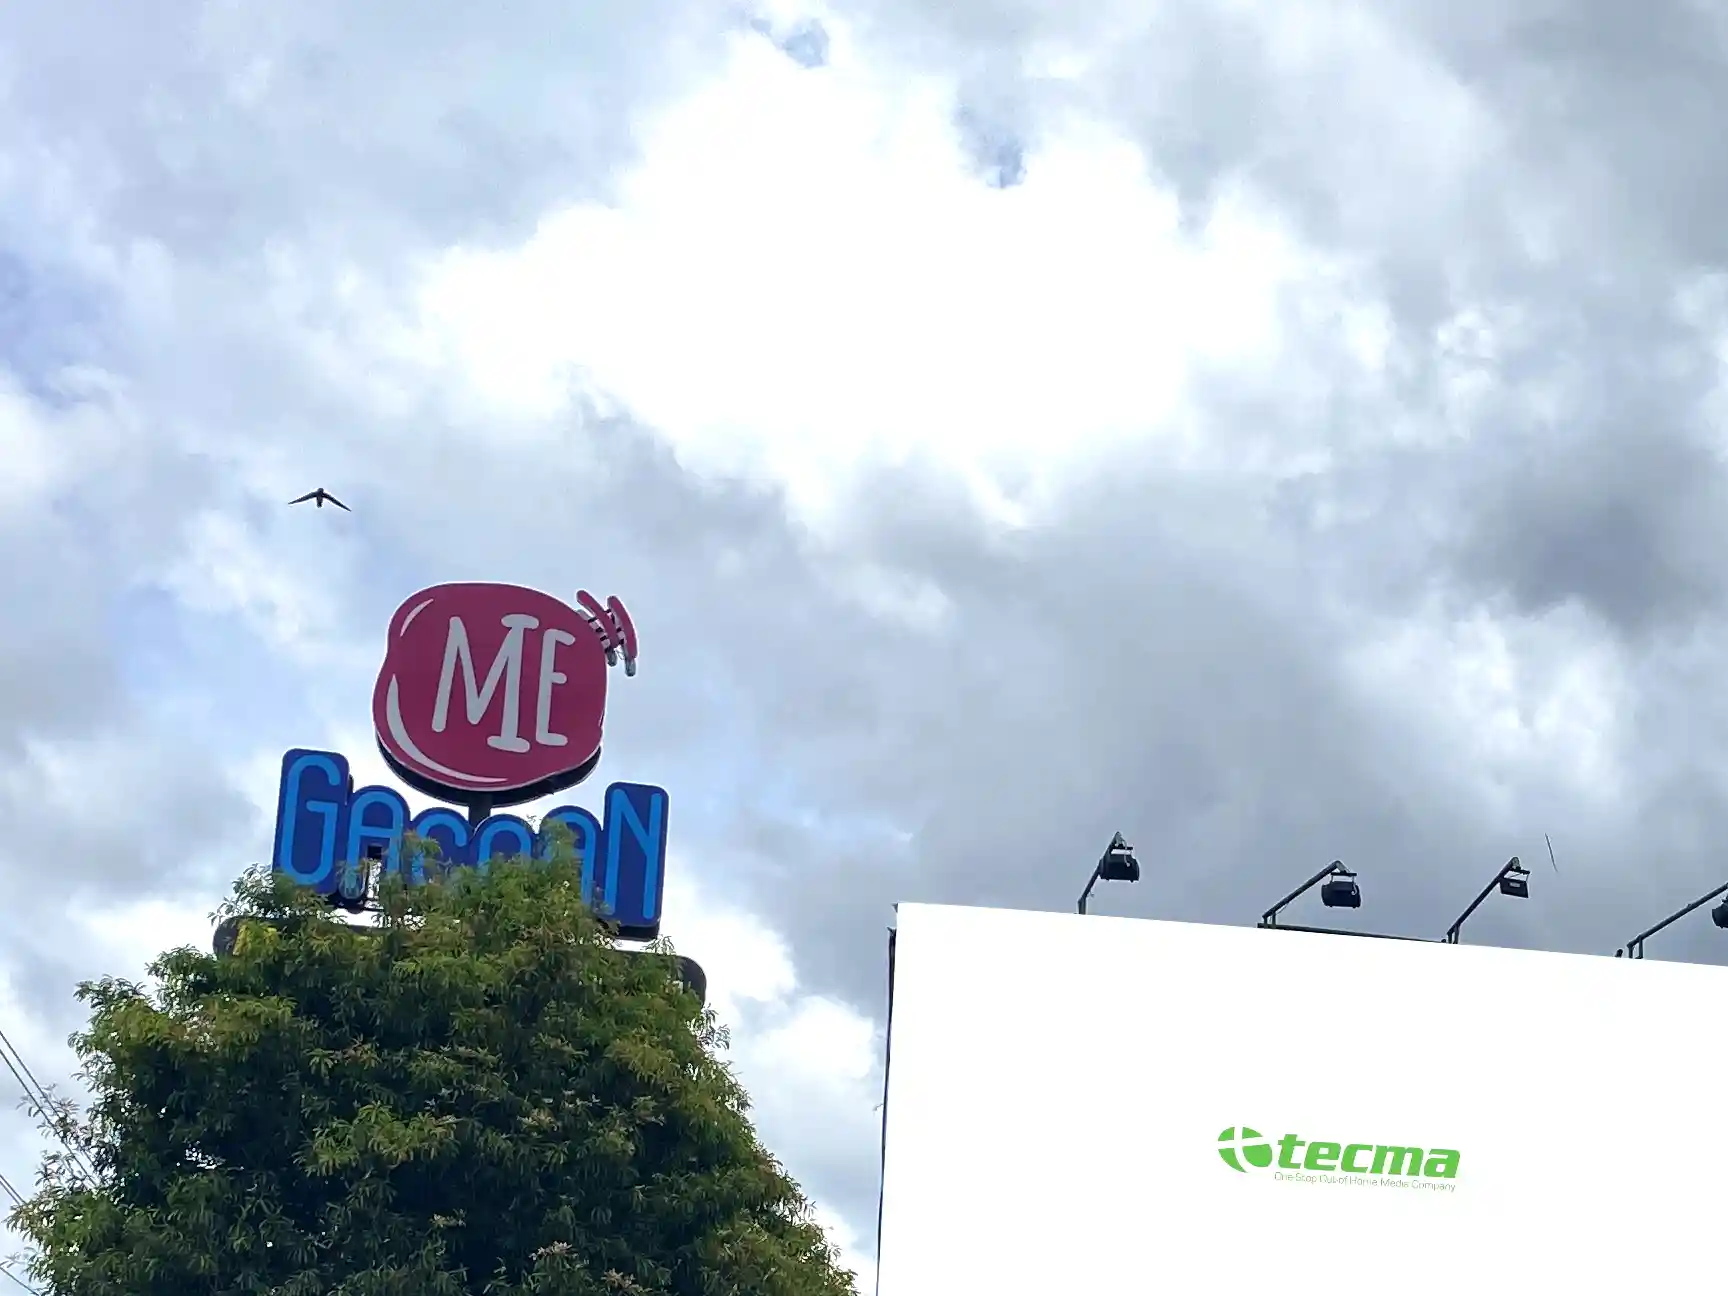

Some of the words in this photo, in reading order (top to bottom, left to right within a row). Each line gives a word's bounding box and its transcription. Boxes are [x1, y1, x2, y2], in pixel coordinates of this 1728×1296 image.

[1277, 1133, 1461, 1179] tecma
[1380, 1178, 1409, 1189] Media
[1411, 1179, 1456, 1193] Company
